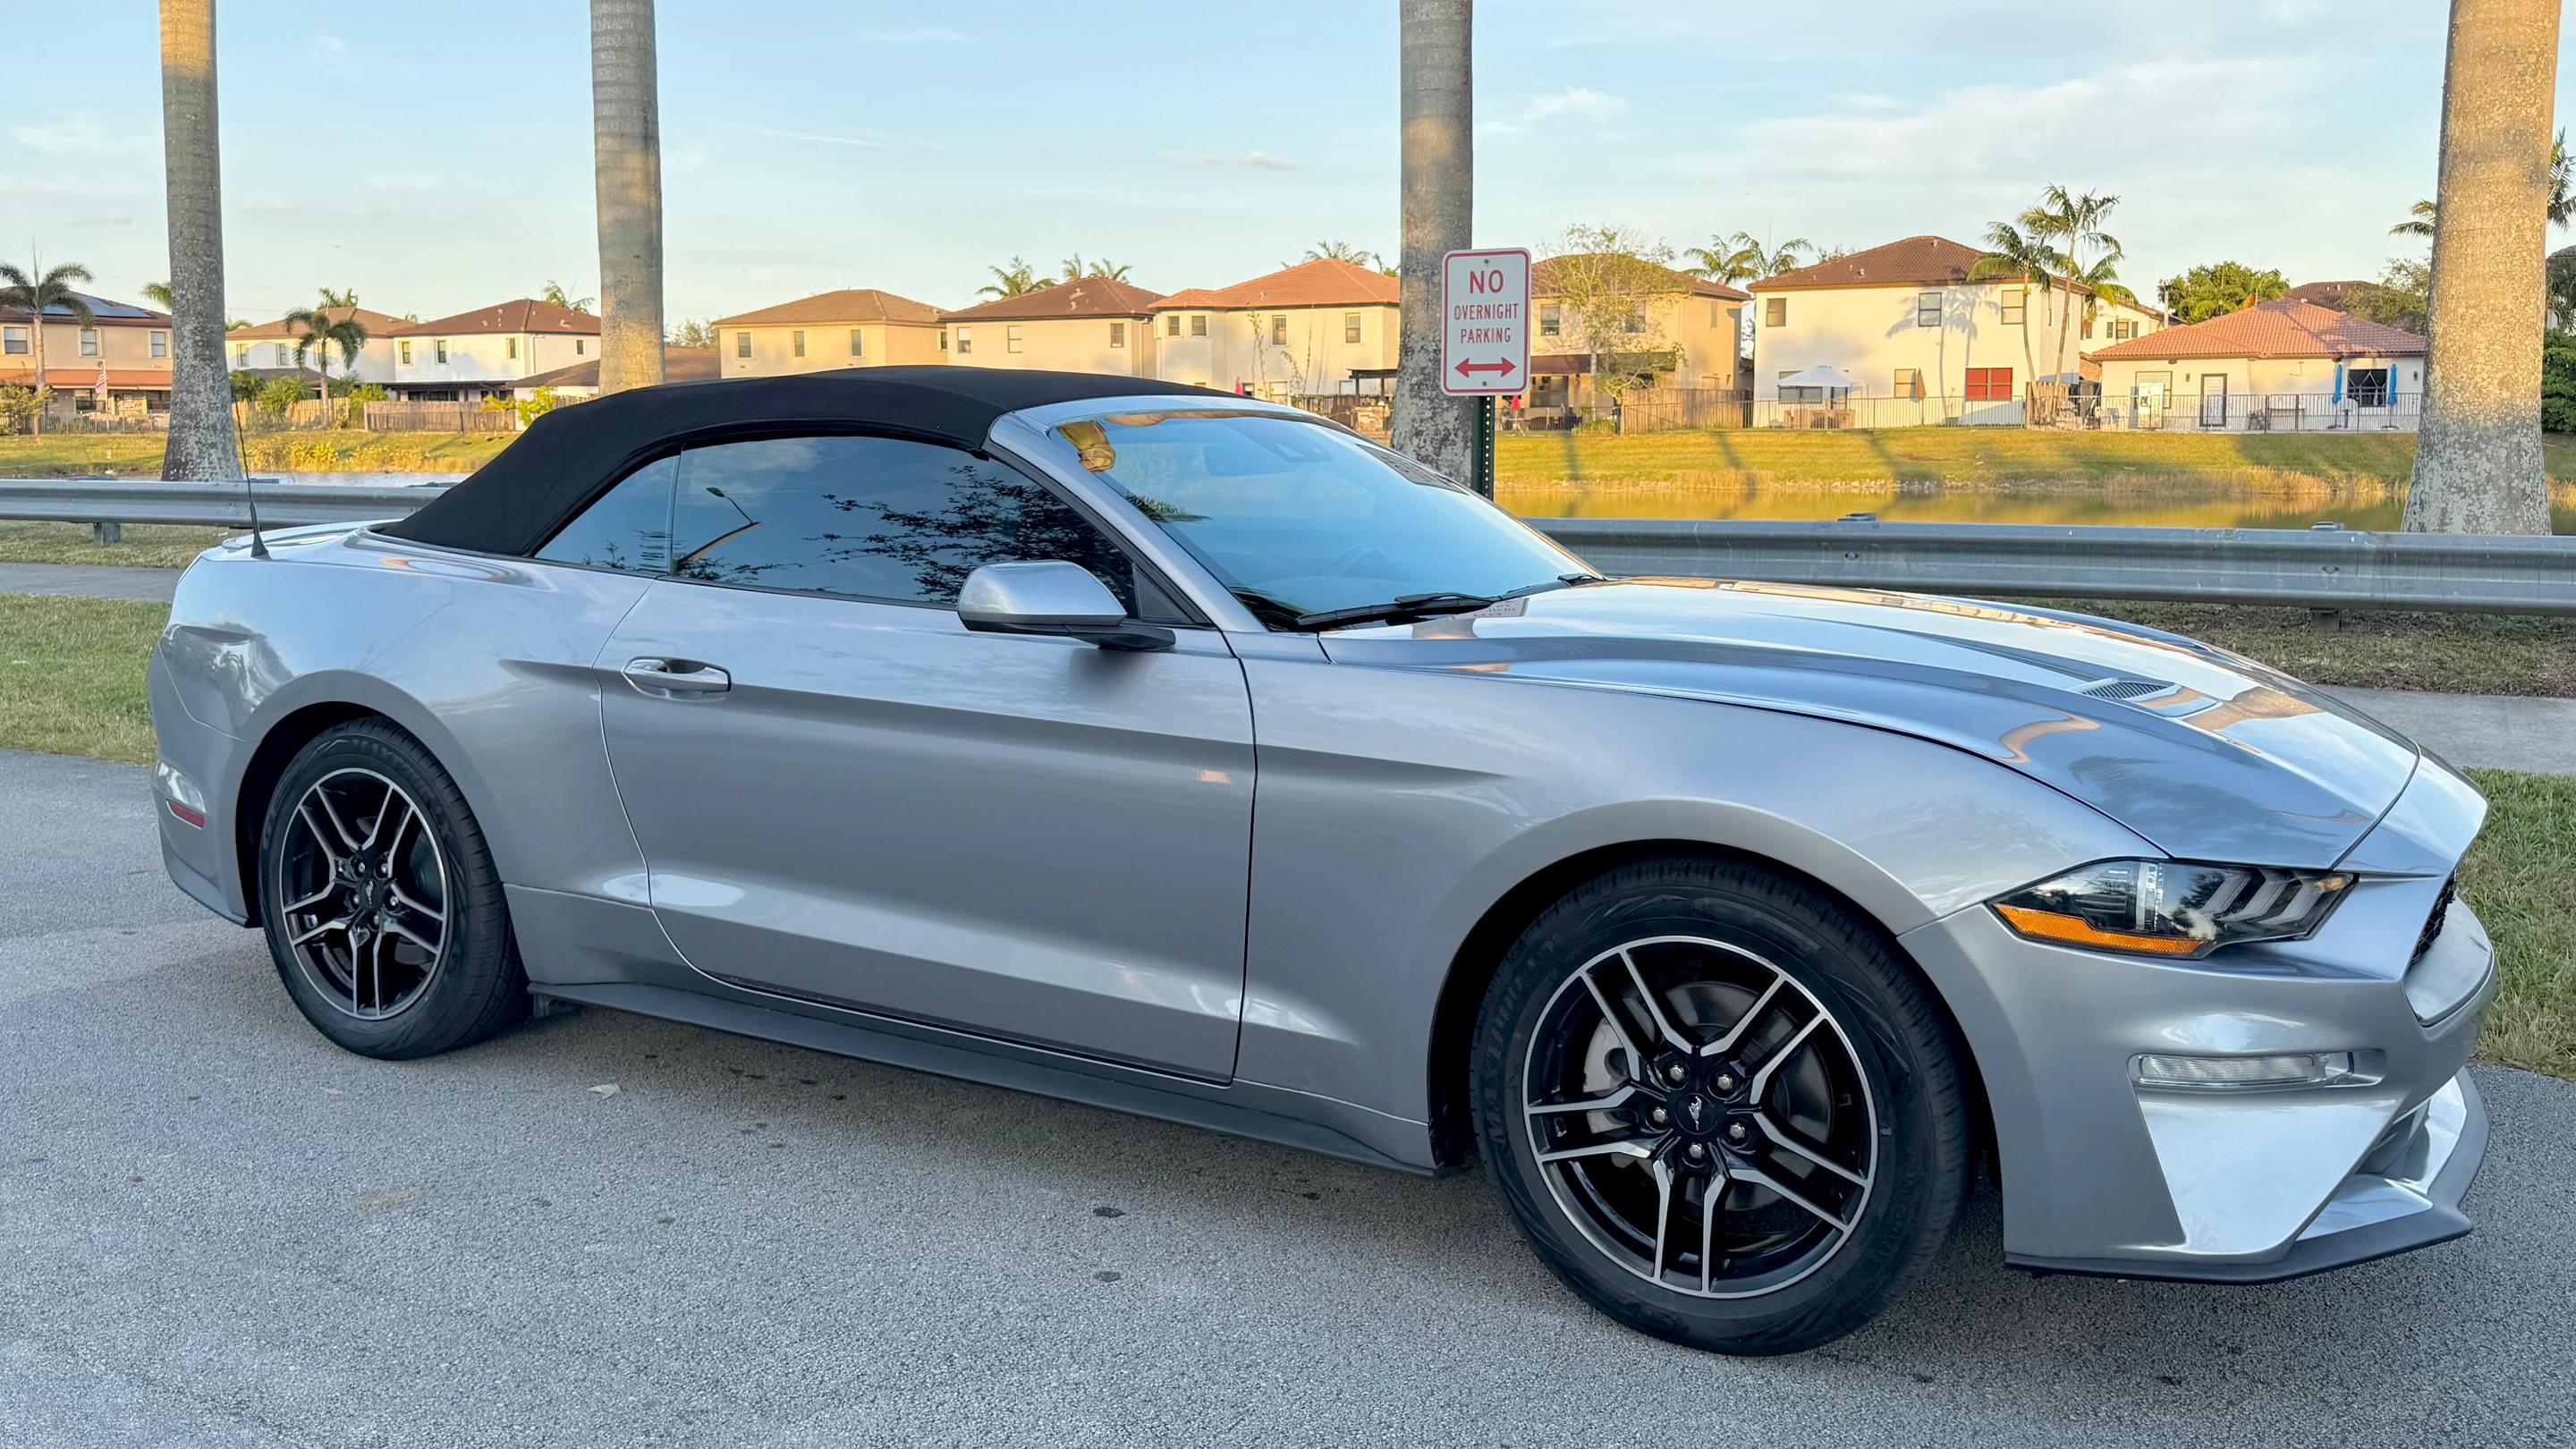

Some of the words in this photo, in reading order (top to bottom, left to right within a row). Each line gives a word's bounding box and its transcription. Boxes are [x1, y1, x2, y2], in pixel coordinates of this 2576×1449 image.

[1470, 269, 1504, 294] NO
[1454, 303, 1519, 320] OVERNIGHT
[1461, 327, 1511, 343] PARKING
